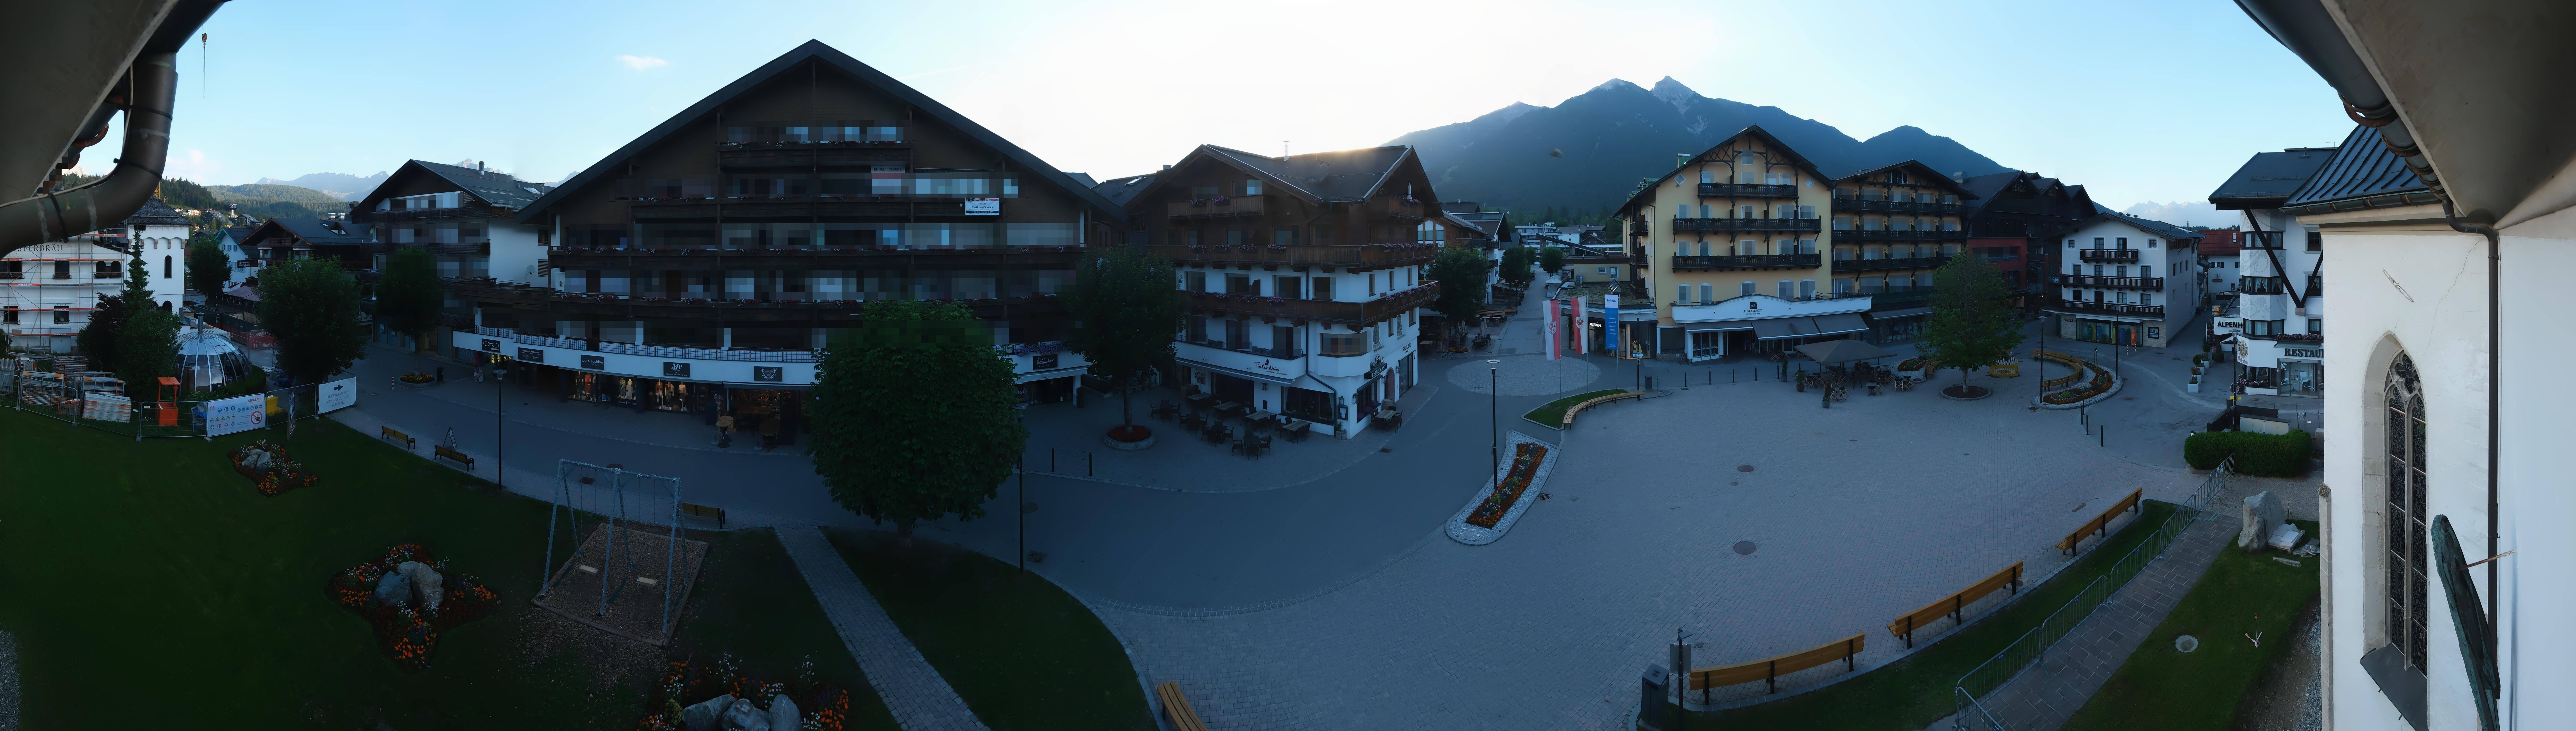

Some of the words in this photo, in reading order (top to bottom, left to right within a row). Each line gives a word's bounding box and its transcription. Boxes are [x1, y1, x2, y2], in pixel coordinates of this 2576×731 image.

[1402, 343, 1411, 352] SAILER
[671, 363, 682, 373] My
[1372, 364, 1386, 377] RESTAURANT
[326, 395, 349, 404] KONGRESSZENTRUM
